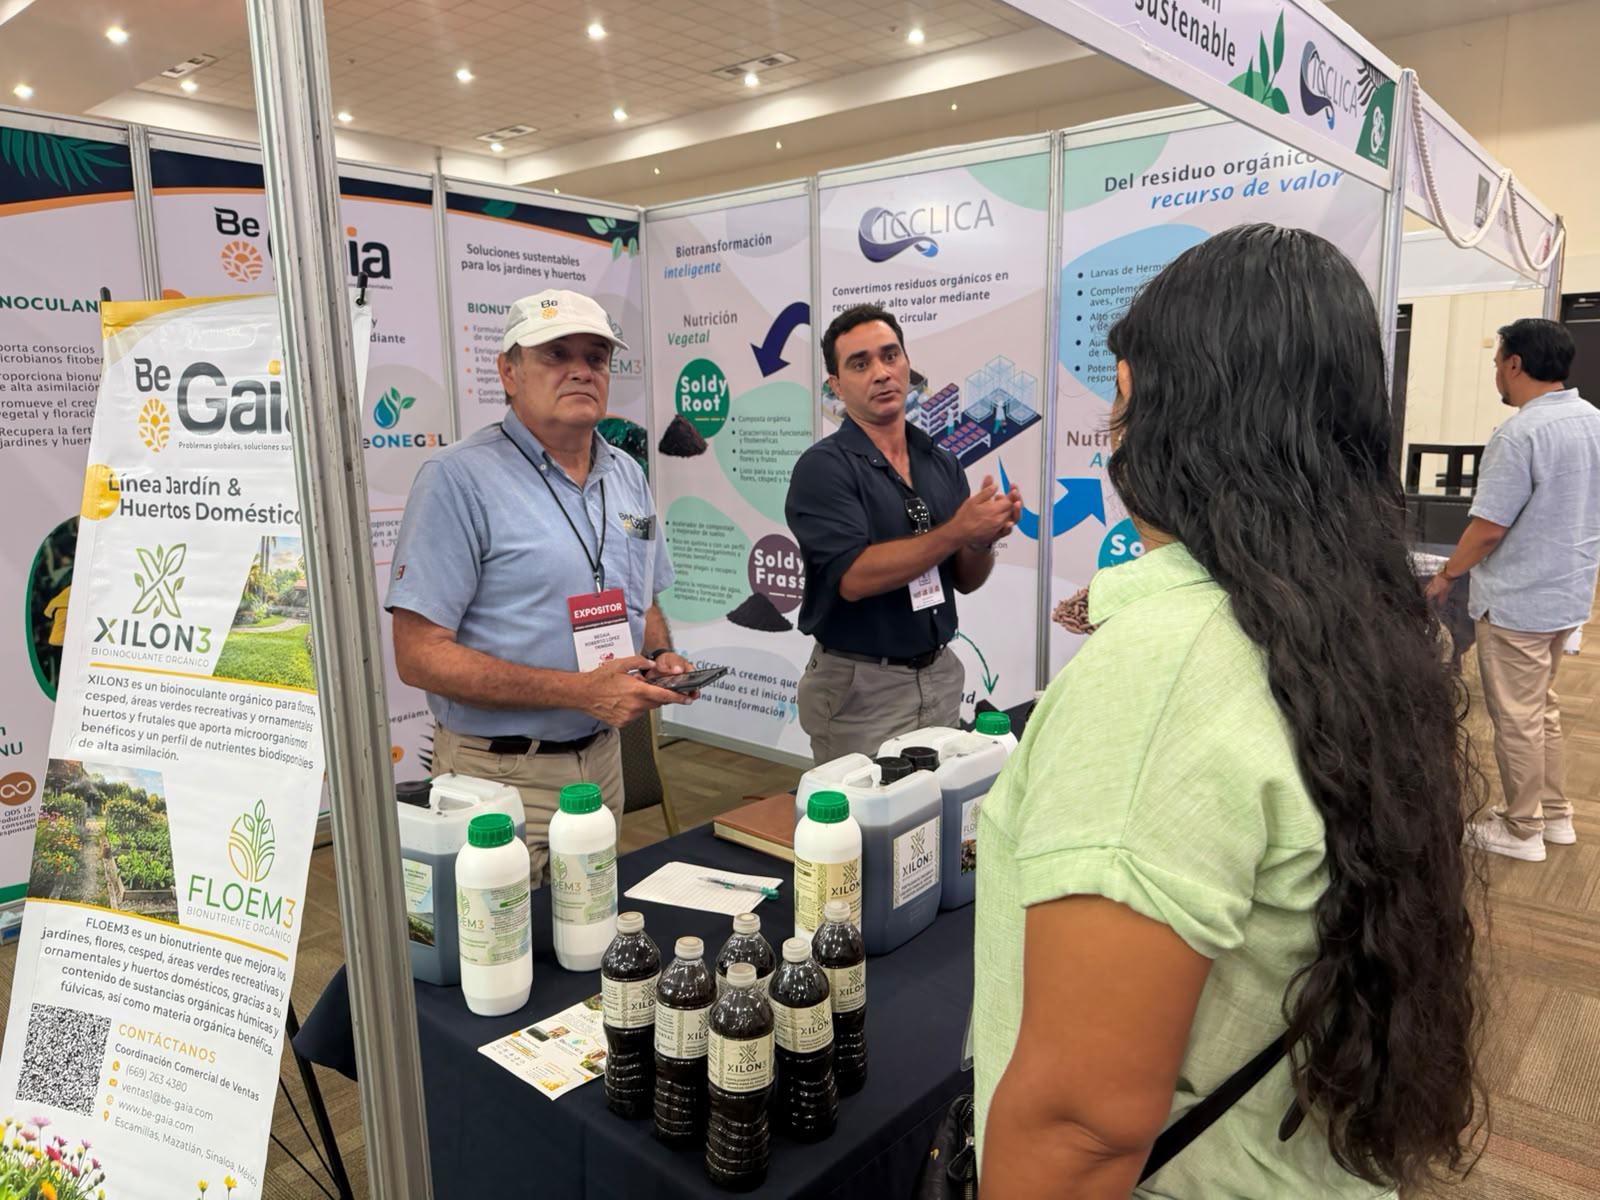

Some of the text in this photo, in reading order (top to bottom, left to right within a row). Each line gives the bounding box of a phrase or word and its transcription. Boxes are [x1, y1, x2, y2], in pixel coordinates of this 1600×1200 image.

[1104, 173, 1134, 193] Del
[1141, 164, 1216, 187] residuo
[1151, 169, 1345, 209] recurso de valor
[214, 206, 260, 237] Be
[466, 243, 580, 267] Soluciones sustentables
[676, 233, 773, 258] Biotransformación
[461, 259, 587, 282] para los jardines huertos
[664, 262, 722, 280] inteligente
[1090, 264, 1135, 278] Larvas de
[832, 271, 1010, 297] Convertimos residuos orgánicos en
[888, 289, 991, 308] alto valor mediante
[683, 310, 738, 328] Nutrición
[899, 312, 938, 323] circular
[32, 344, 95, 354] consorcios
[667, 330, 710, 348] Vegetal
[11, 382, 33, 392] alta
[134, 358, 171, 392] Be
[680, 374, 727, 397] Soldy
[57, 398, 67, 408] el
[177, 360, 292, 436] Gai
[681, 394, 721, 412] Root
[58, 425, 68, 436] la
[178, 441, 280, 451] Problemas globales, soluciones
[109, 473, 241, 496] Línea Jardín &
[120, 499, 191, 520] Huertos
[754, 549, 804, 575] Soldy
[756, 568, 806, 589] Frass
[574, 603, 623, 619] EXPOSITOR
[93, 616, 212, 654] XILON3
[91, 647, 210, 668] BIOINOCULANTE ORGÁNICO
[738, 670, 797, 689] creemos que
[87, 674, 130, 689] XILON3
[131, 681, 142, 690] es
[145, 681, 158, 691] un
[160, 682, 227, 701] bioinoculante
[229, 690, 273, 708] orgánico
[275, 700, 297, 712] para
[738, 686, 787, 703] es el inicio
[85, 690, 313, 733] cesped, áreas verdes recreativas ornamentales
[714, 694, 786, 719] transformación
[81, 722, 136, 738] benéficos
[146, 730, 159, 741] un
[161, 731, 189, 748] perfil
[190, 736, 203, 748] de
[205, 739, 256, 757] nutrientes
[82, 706, 308, 750] huertos frutales que aporta microorganismos
[78, 738, 180, 761] de alta asimilación.
[902, 851, 934, 877] XILON3
[187, 874, 296, 929] FLOEM3
[186, 906, 292, 944] BIONUTRIENTE ORGÁNICO
[86, 917, 130, 936] FLOEM3
[131, 929, 142, 939] es
[144, 931, 157, 943] un
[159, 933, 223, 959] bionutriente
[224, 951, 243, 966] que
[244, 954, 276, 977] mejora
[41, 927, 280, 998] jardines, flores, cesped, áreas verdes recreativas
[44, 945, 282, 1019] ornamentales huertos domésticos, gracias su
[61, 964, 273, 1034] contenido de sustancias orgánicas húmicas
[60, 979, 275, 1057] fúlvicas, así como materia orgánica benéfica.
[118, 1023, 217, 1064] CONTÁCTANOS
[115, 1043, 261, 1102] Coordinación Comercial de Ventas
[125, 1064, 189, 1093] (669) 263 4380
[118, 1100, 195, 1134] www.be-gaia.com
[115, 1116, 160, 1143] Escamillas,
[162, 1132, 204, 1160] Mazatlán,
[205, 1149, 237, 1173] Sinaloa,
